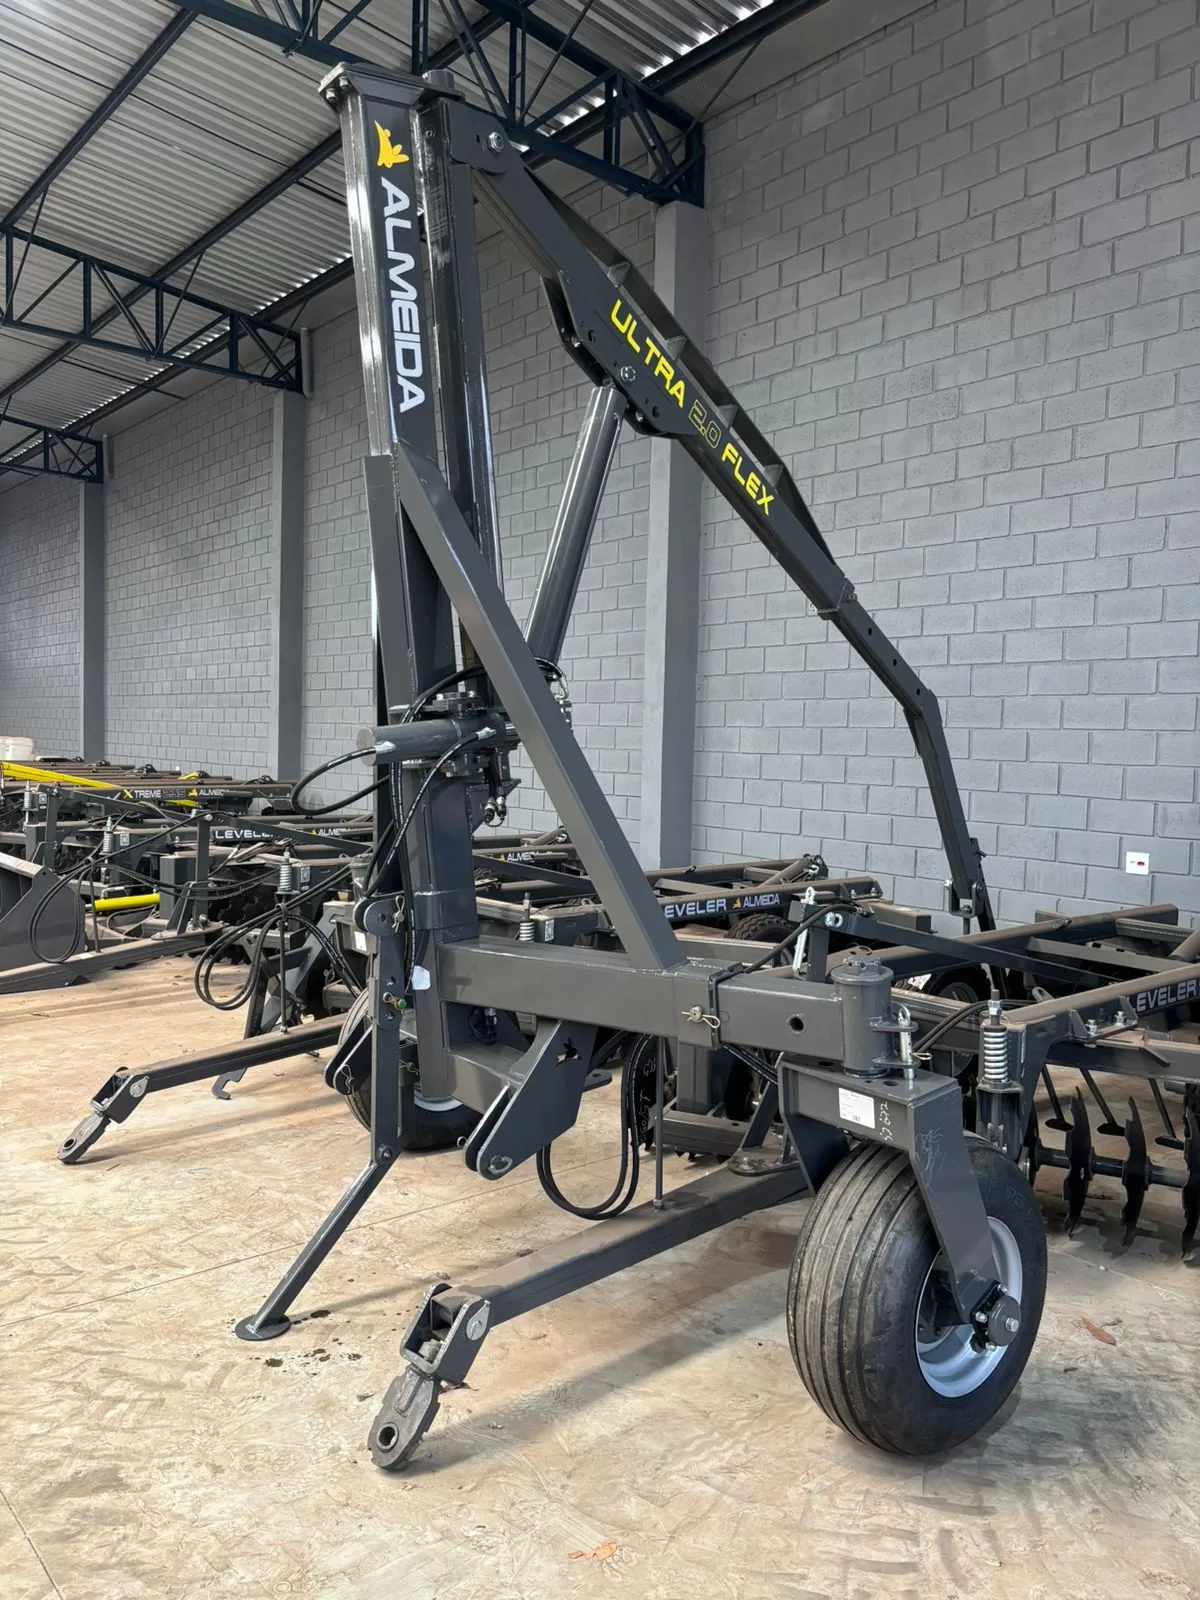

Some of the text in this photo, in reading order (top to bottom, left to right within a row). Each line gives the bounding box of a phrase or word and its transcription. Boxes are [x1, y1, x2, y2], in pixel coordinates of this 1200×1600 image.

[380, 177, 426, 413] ALMEIDA
[611, 299, 775, 516] ULTRA 2.0 FLEX
[215, 829, 273, 839] LEVEL
[664, 897, 727, 919] EVELER
[1133, 979, 1196, 1012] EVELER
